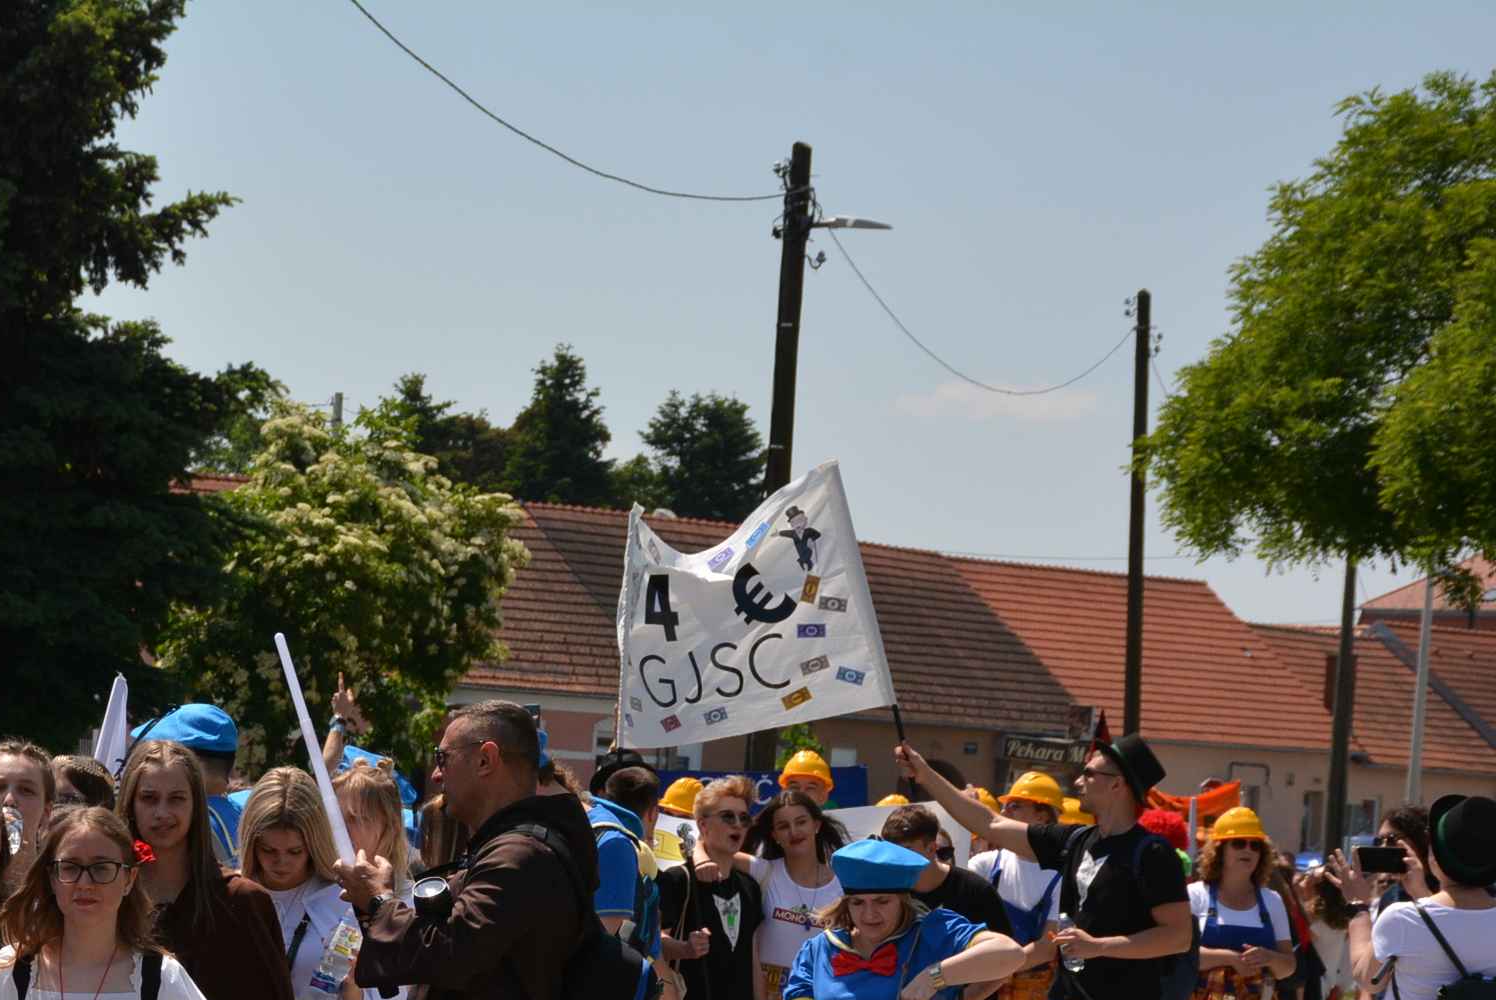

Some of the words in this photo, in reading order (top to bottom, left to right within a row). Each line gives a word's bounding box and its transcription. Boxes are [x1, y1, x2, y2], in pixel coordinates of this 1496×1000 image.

[644, 574, 679, 642] 4
[639, 633, 791, 708] GJSC
[1007, 740, 1065, 761] Pekara
